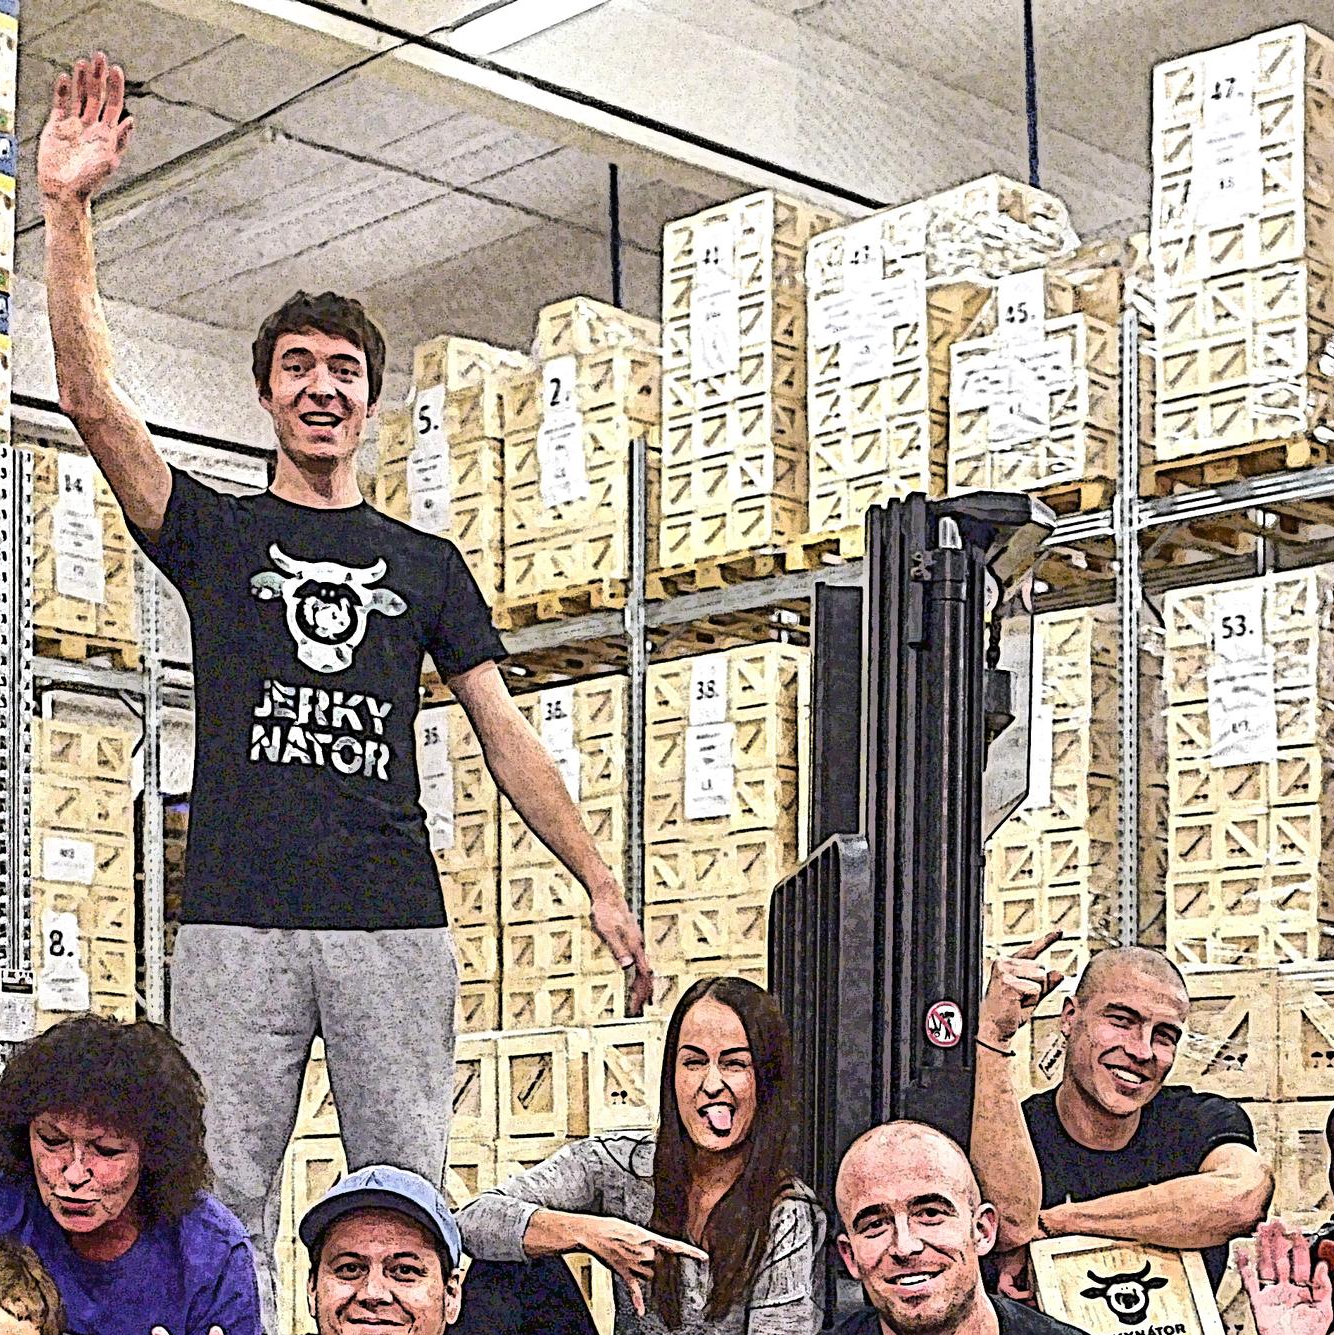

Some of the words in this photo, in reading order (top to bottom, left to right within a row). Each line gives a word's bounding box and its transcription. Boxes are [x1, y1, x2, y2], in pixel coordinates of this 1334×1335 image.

[418, 404, 440, 434] 5.
[1221, 616, 1255, 640] 53.
[254, 679, 393, 736] JERKY
[248, 724, 393, 781] NATOR
[48, 929, 74, 958] 8.
